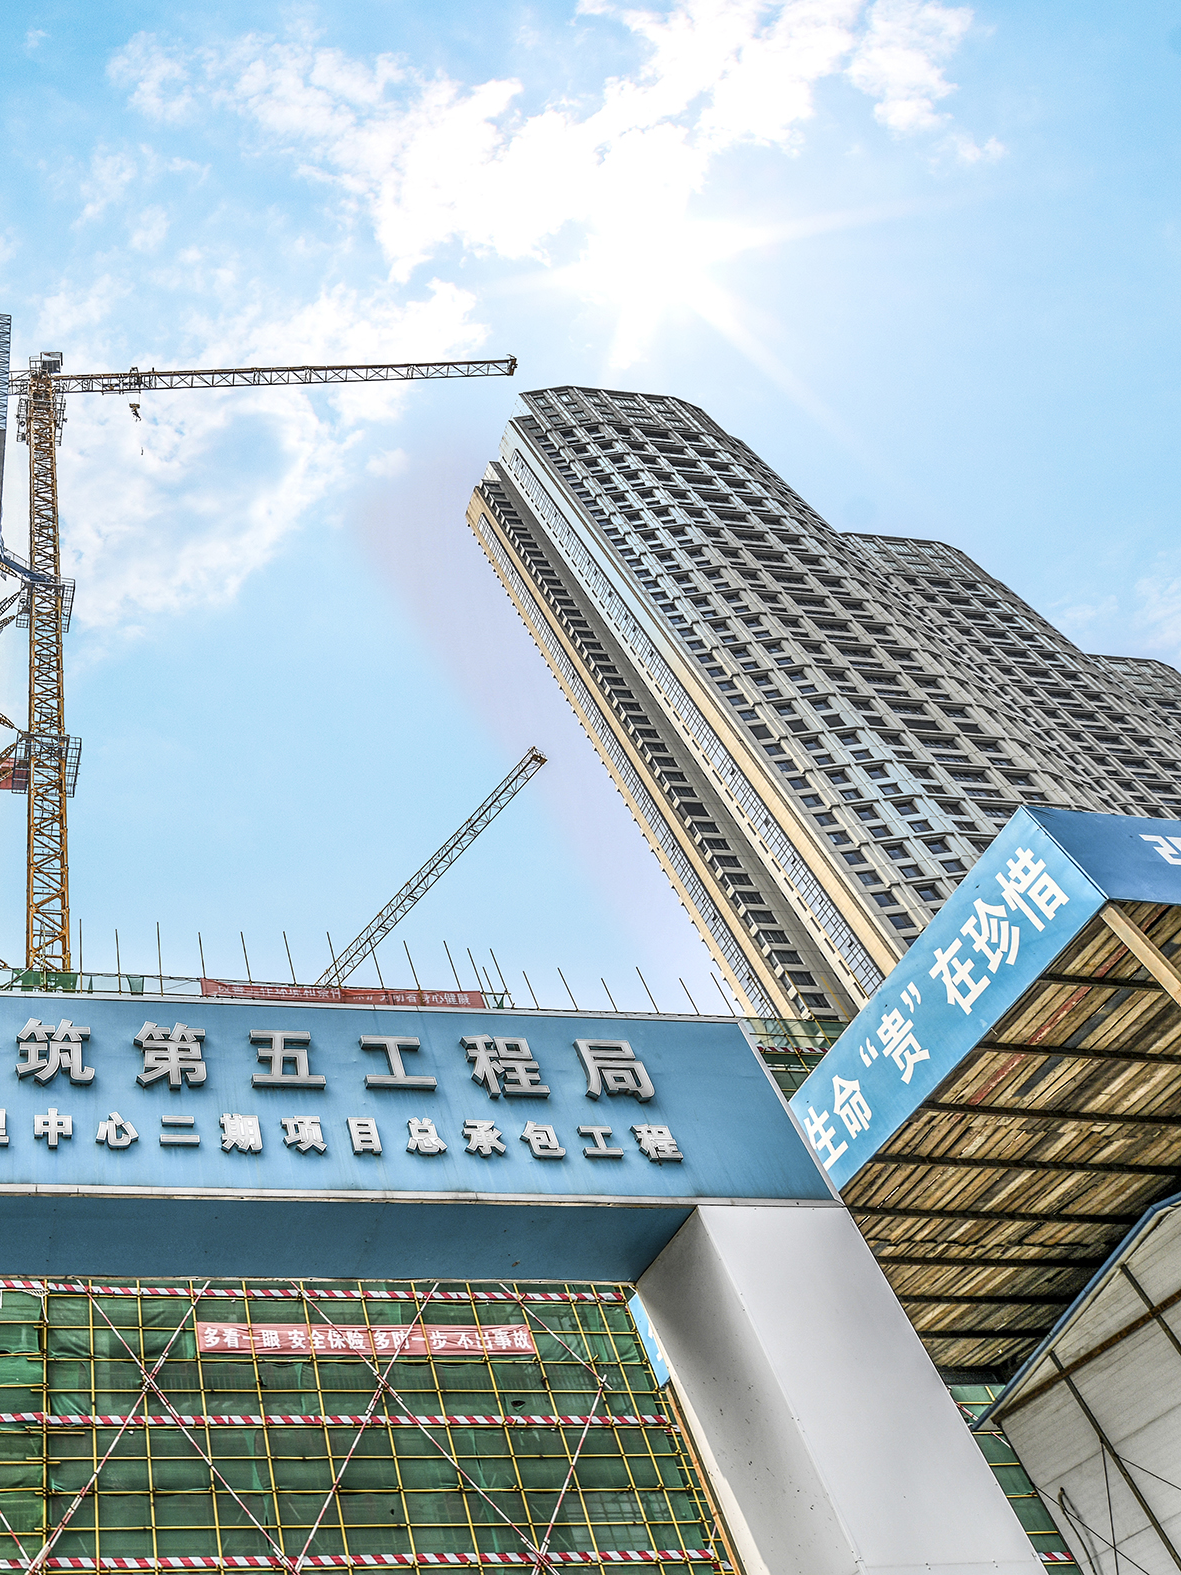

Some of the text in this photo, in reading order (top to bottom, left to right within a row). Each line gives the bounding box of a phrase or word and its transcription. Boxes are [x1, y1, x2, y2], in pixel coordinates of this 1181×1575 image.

[203, 1328, 532, 1350] 多看一眼 安全保险 多防一步 不出事故
